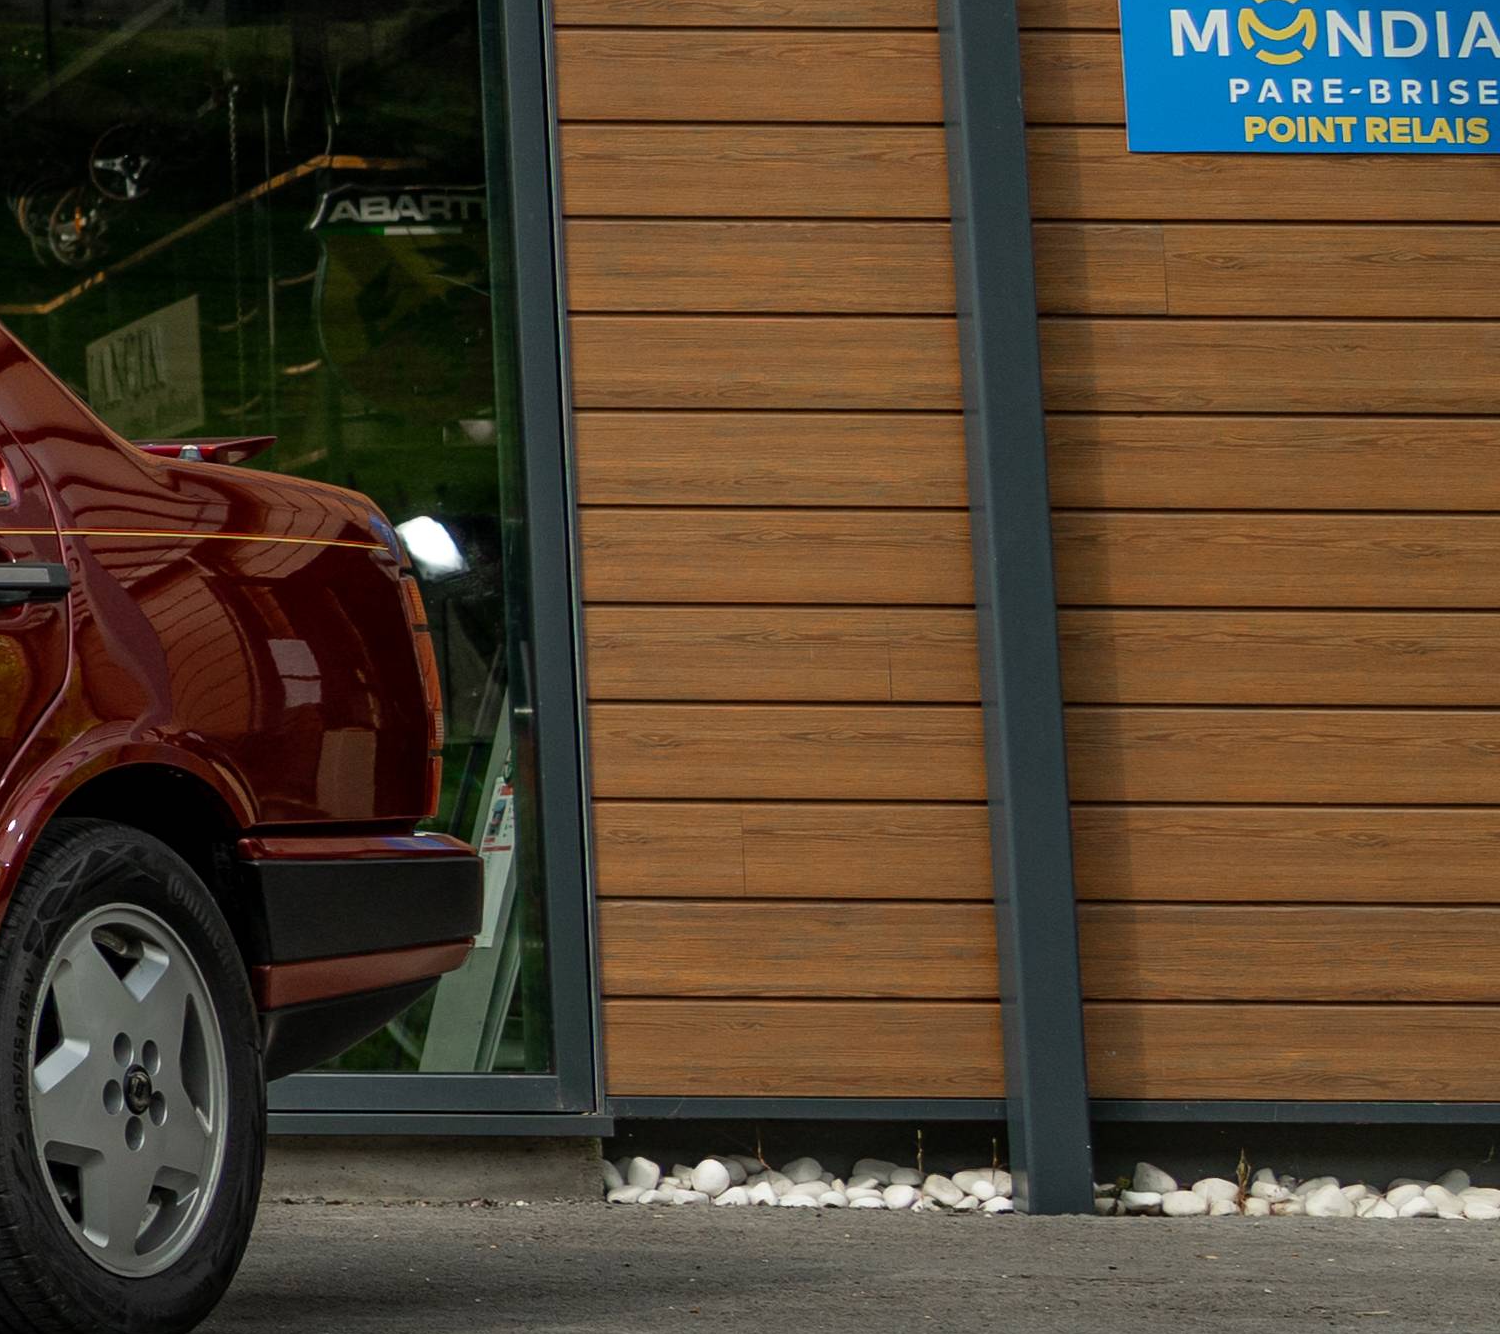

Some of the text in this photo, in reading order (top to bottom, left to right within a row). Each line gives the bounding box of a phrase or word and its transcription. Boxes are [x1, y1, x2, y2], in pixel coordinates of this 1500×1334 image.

[1229, 78, 1500, 105] PARE-BRISE
[1244, 116, 1490, 146] POINT RELAIS
